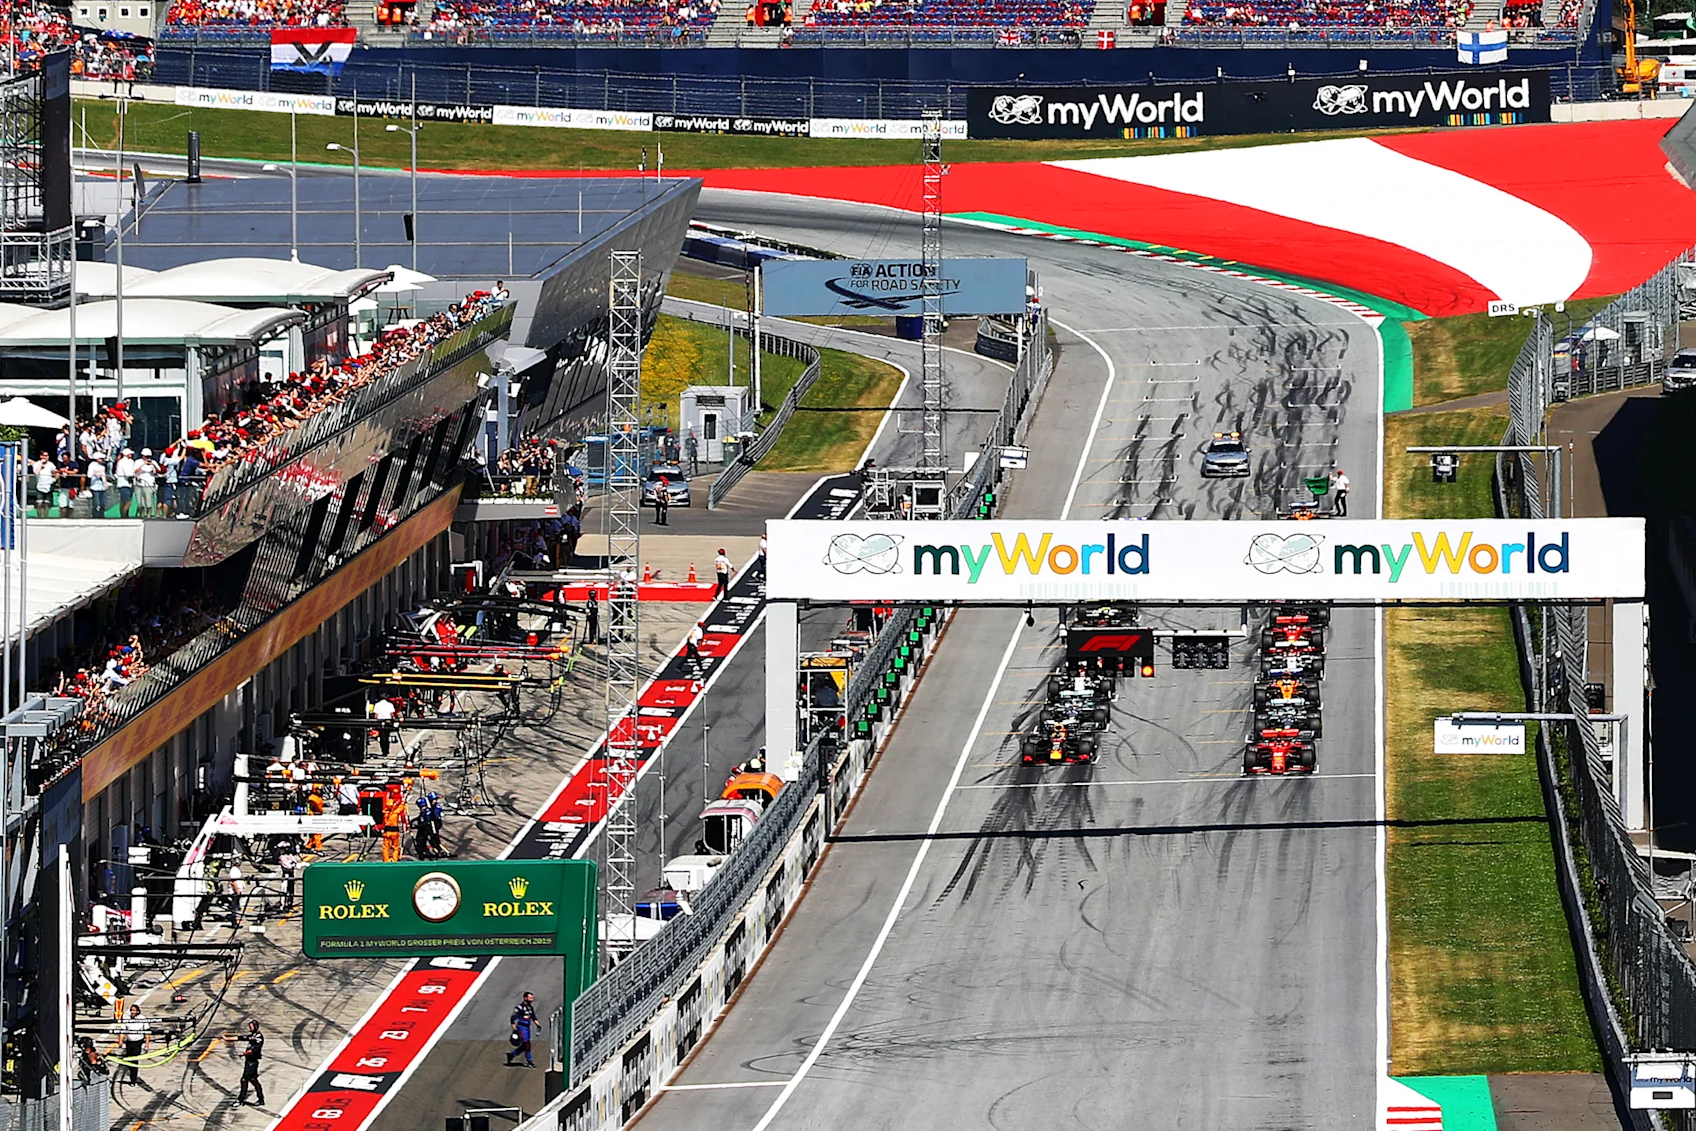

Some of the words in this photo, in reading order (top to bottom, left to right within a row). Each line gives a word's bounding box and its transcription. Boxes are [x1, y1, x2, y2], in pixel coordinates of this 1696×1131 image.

[199, 92, 253, 105] myWorld
[1372, 78, 1530, 117] myWorld
[278, 98, 332, 112] myWorld
[357, 101, 412, 116] myWorld
[1047, 91, 1204, 130] myWorld
[436, 106, 492, 120] myWorld
[517, 110, 571, 124] myWorld
[596, 113, 650, 127] myWorld
[674, 117, 729, 131] myWorld
[753, 119, 808, 134] myWorld
[832, 122, 887, 136] myWorld
[851, 279, 869, 288] FOR
[872, 279, 908, 291] ROAD
[1492, 303, 1515, 313] DRS
[913, 532, 1150, 583] myWorld
[1334, 531, 1571, 583] myWorld
[1462, 734, 1520, 748] myWorld
[319, 904, 390, 920] ROLEX
[483, 901, 554, 917] ROLEX
[320, 940, 359, 948] FORMULA
[365, 939, 406, 947] MYWORLD
[443, 938, 466, 946] PREIS
